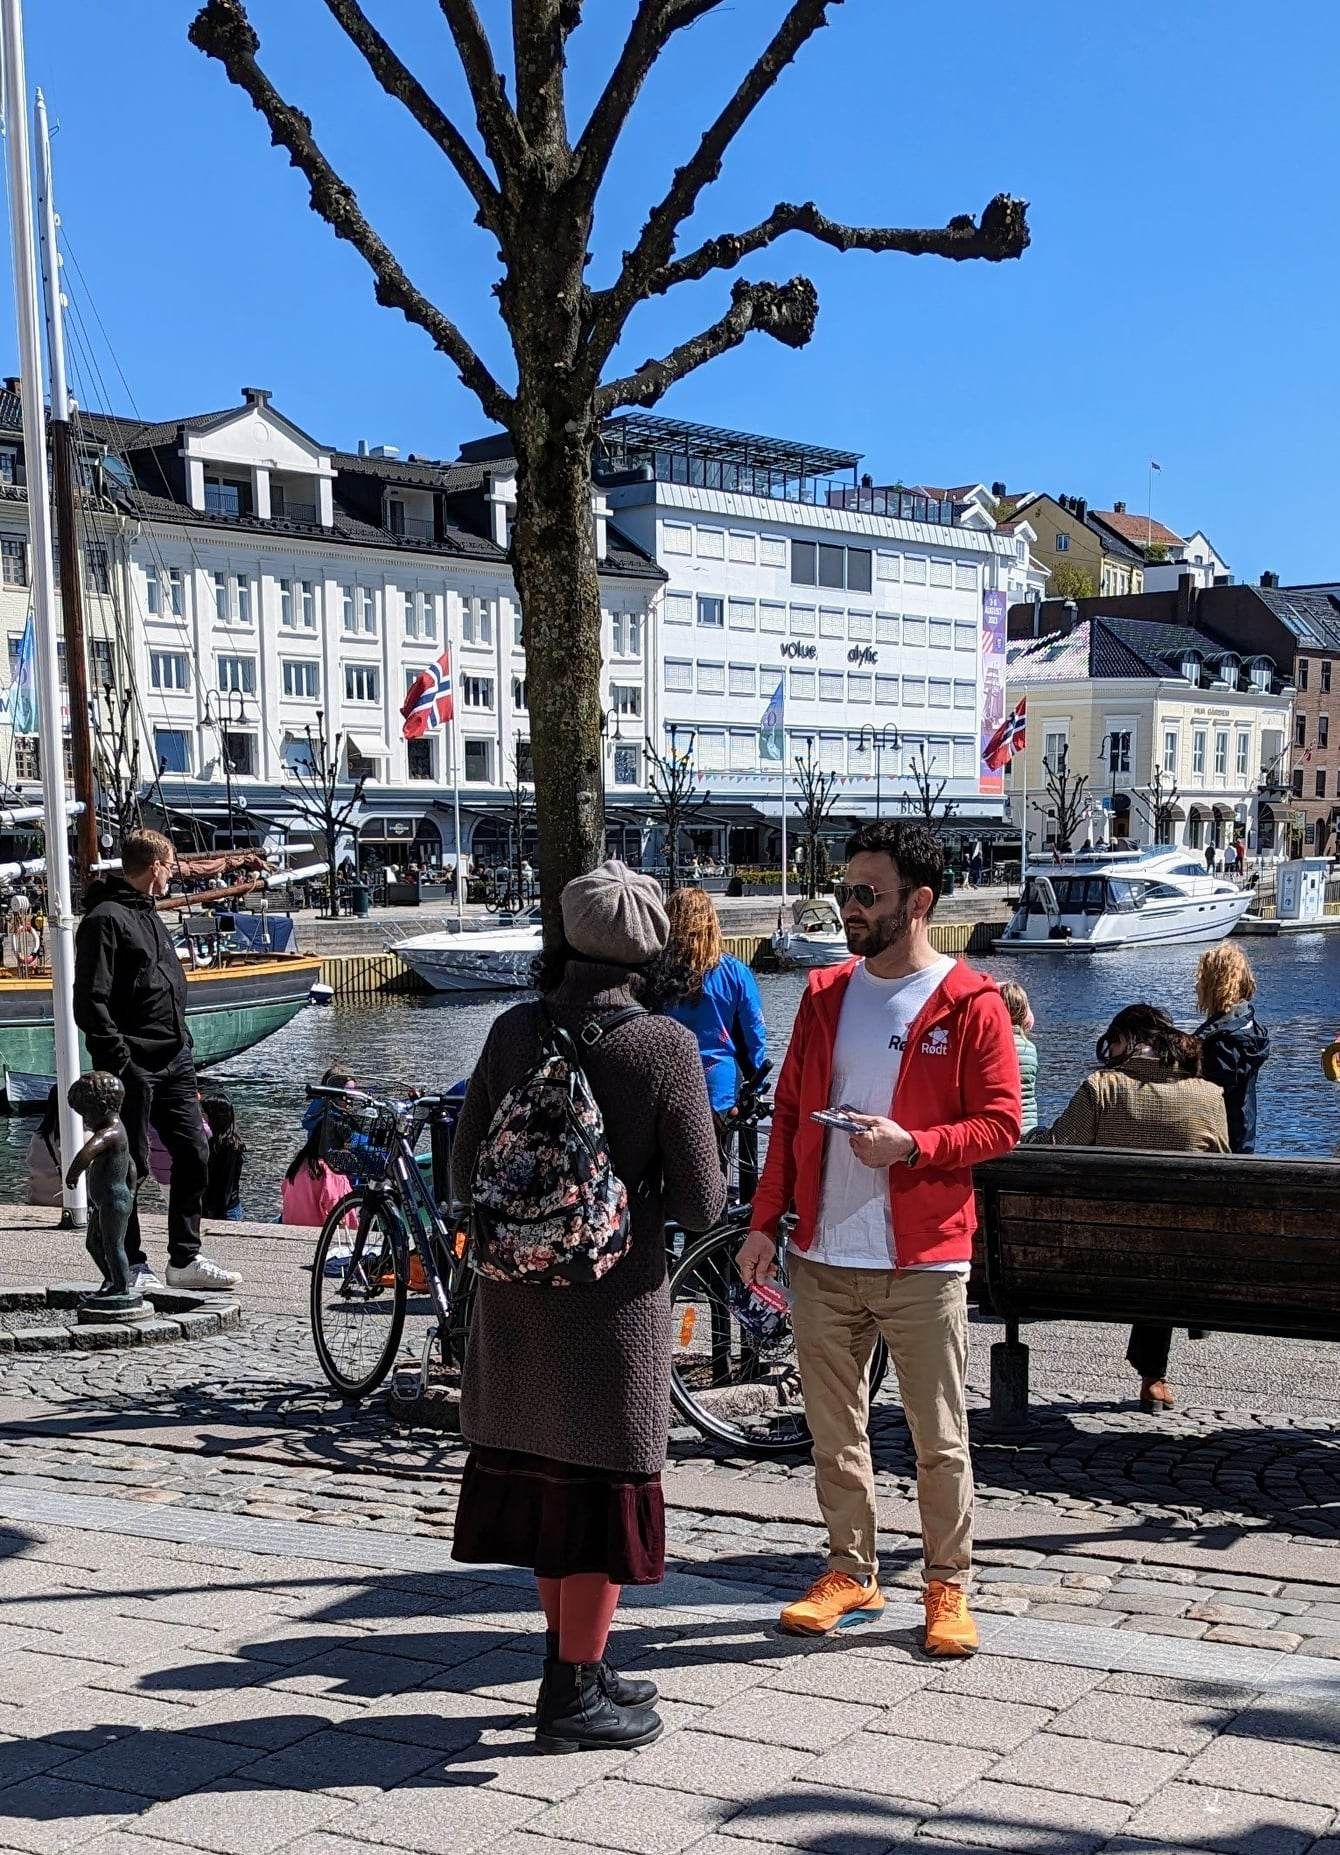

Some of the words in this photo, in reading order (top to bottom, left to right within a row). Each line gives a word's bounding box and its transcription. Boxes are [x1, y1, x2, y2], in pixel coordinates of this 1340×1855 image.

[985, 606, 1003, 616] AUGUST
[900, 800, 929, 815] BLO
[921, 1043, 948, 1056] Rødt
